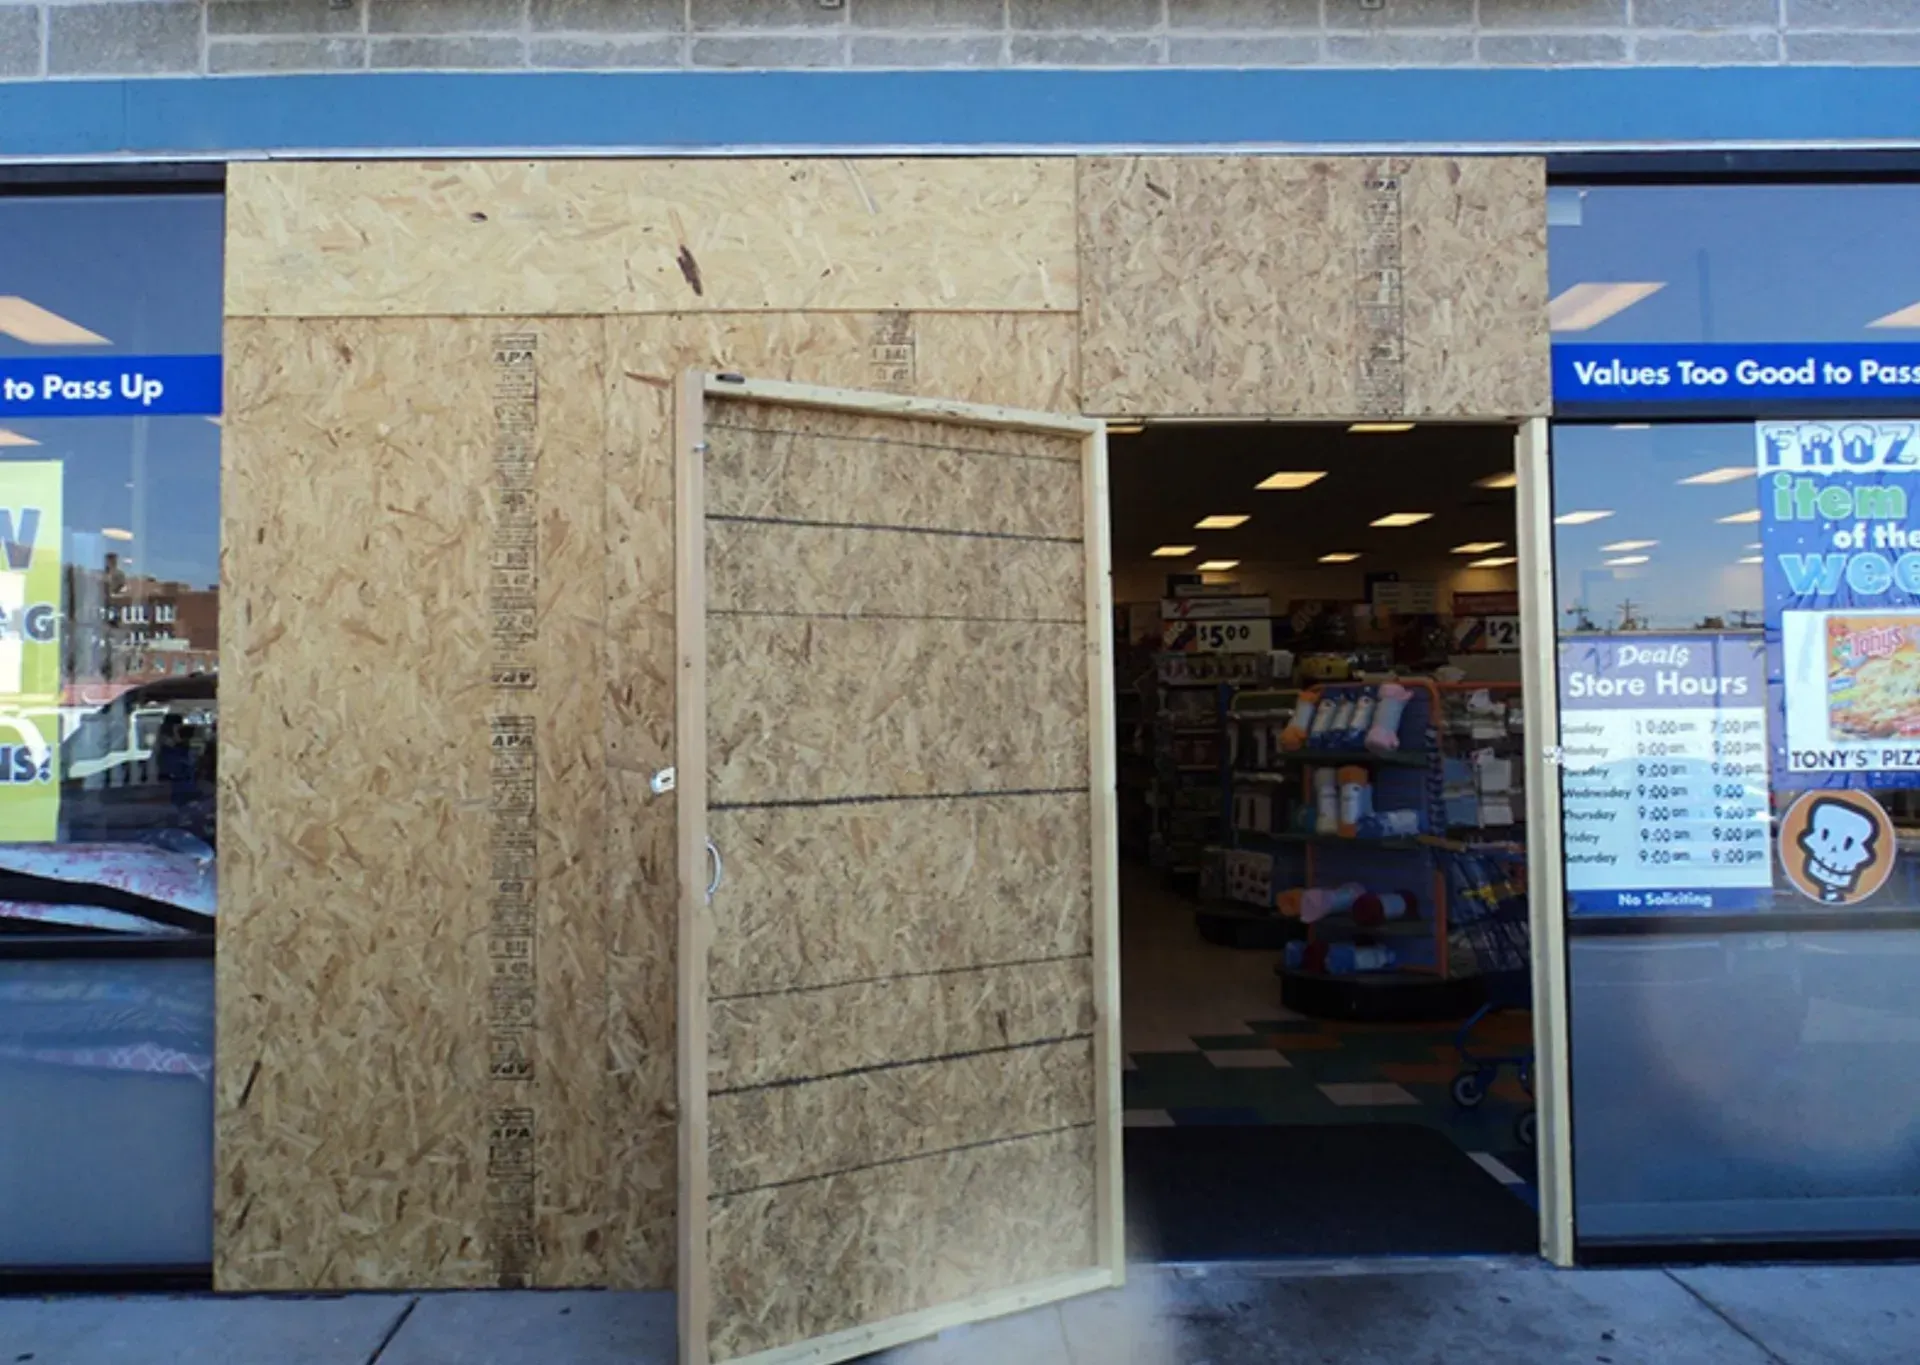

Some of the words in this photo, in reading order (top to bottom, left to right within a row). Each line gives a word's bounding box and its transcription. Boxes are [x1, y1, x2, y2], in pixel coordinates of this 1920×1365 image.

[1573, 360, 1671, 386] Values
[1677, 360, 1729, 386] Too
[1735, 358, 1816, 385] Good
[1823, 361, 1853, 385] to
[3, 377, 35, 401] to
[42, 373, 113, 400] Pass
[120, 372, 164, 407] Up
[1763, 423, 1919, 466] FROZ
[1773, 472, 1907, 521] item
[1832, 521, 1866, 549] of
[1490, 619, 1519, 644] $2
[1568, 671, 1646, 698] Store
[1656, 669, 1749, 696] Hours
[1617, 892, 1642, 907] No
[1644, 890, 1713, 909] Soliciting
